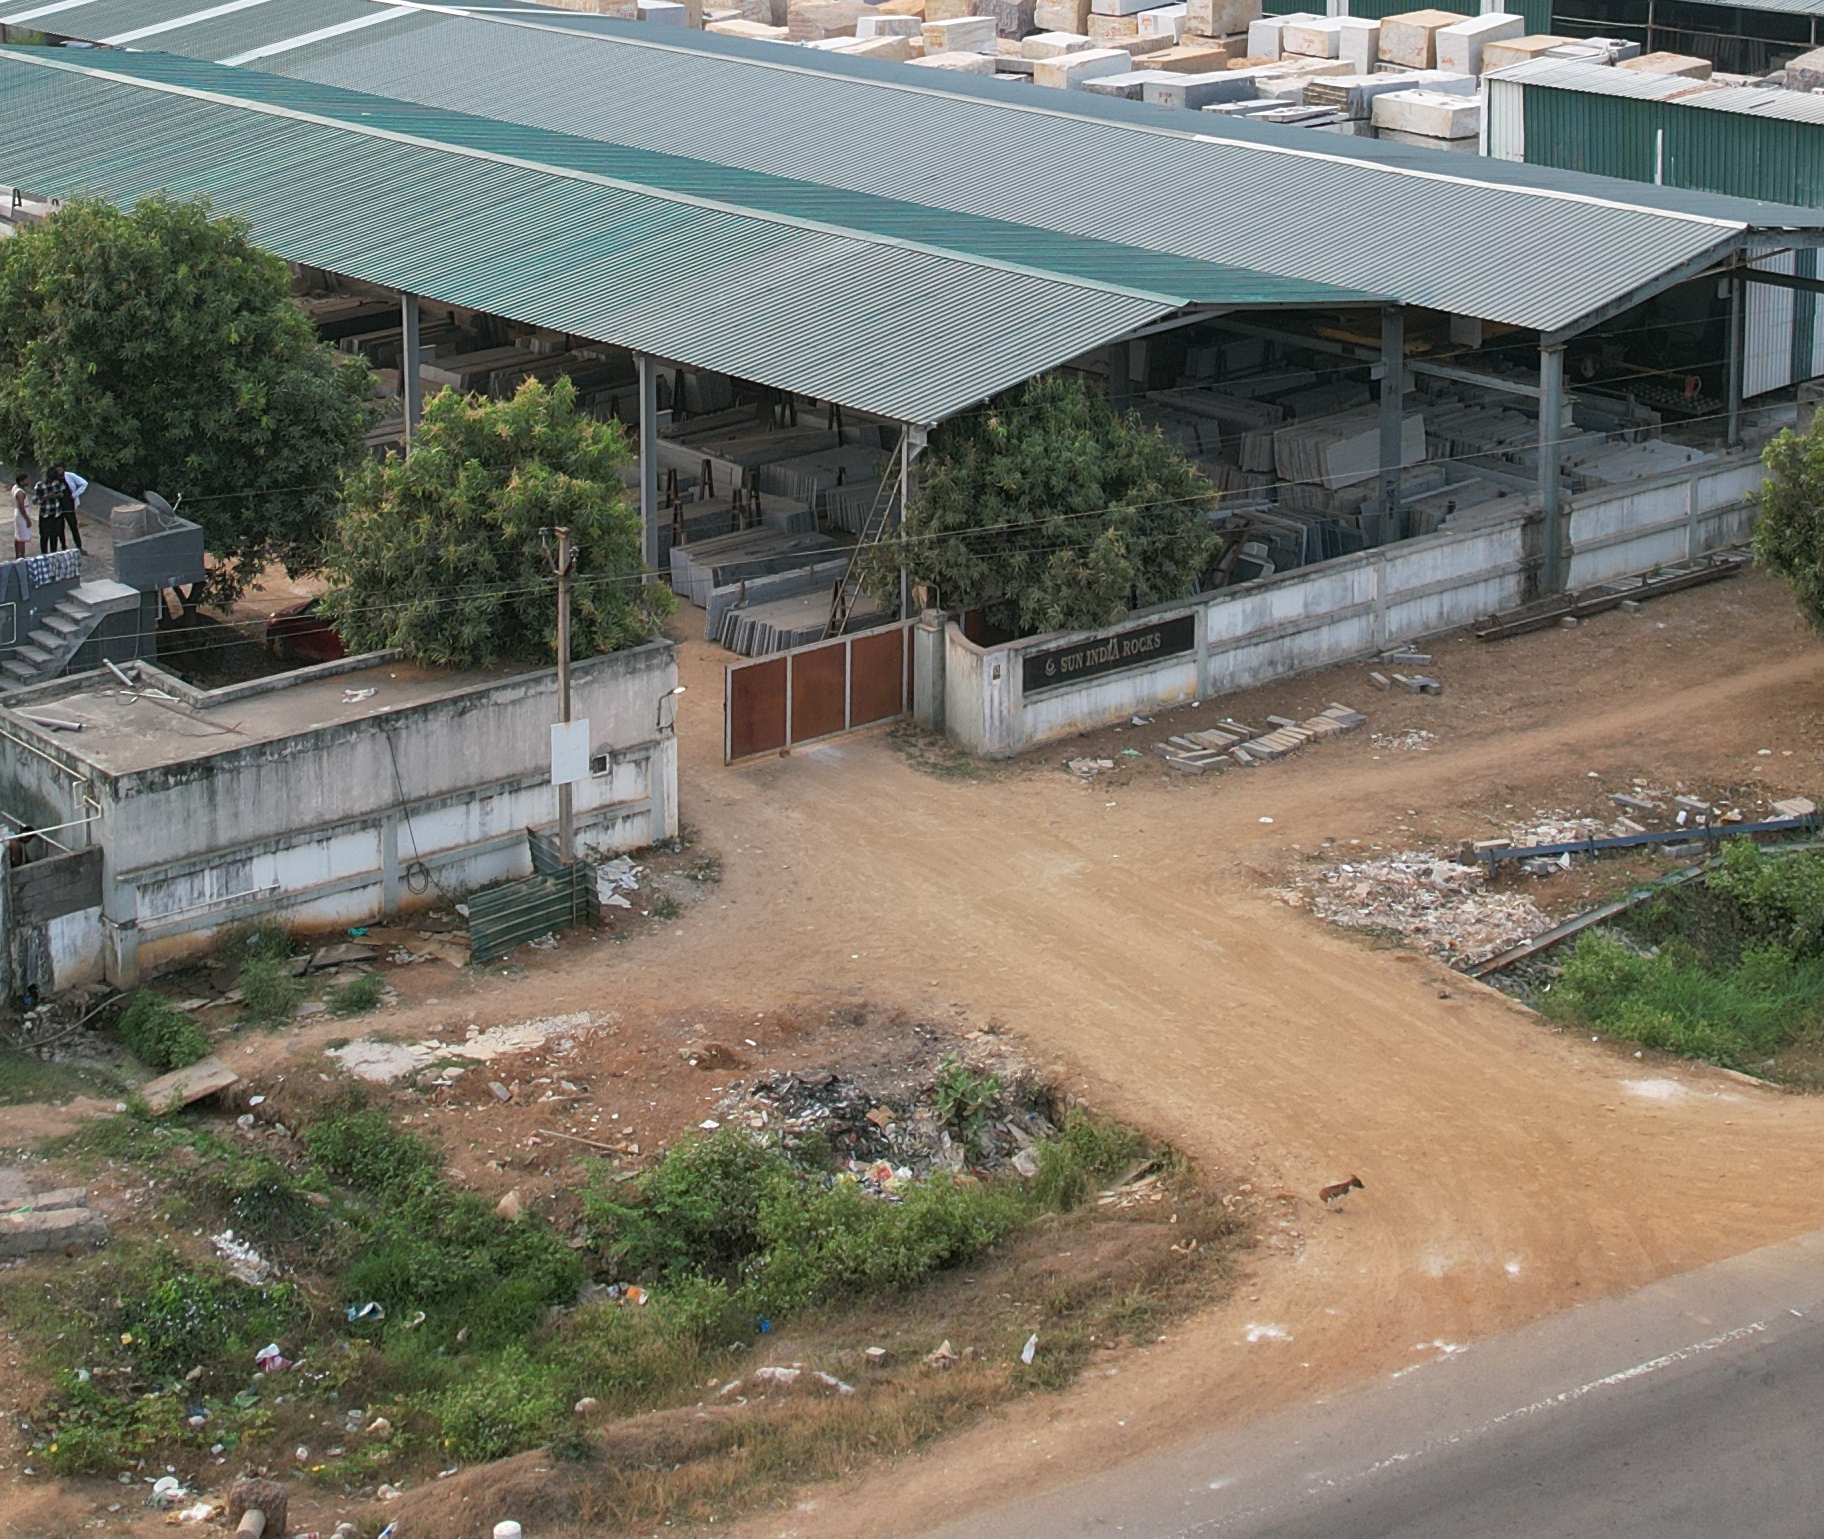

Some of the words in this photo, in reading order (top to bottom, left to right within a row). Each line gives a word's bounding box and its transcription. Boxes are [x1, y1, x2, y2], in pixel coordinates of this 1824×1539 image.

[1060, 652, 1084, 673] SUN
[1086, 639, 1120, 667] INDIA
[1122, 632, 1161, 657] ROCKS
